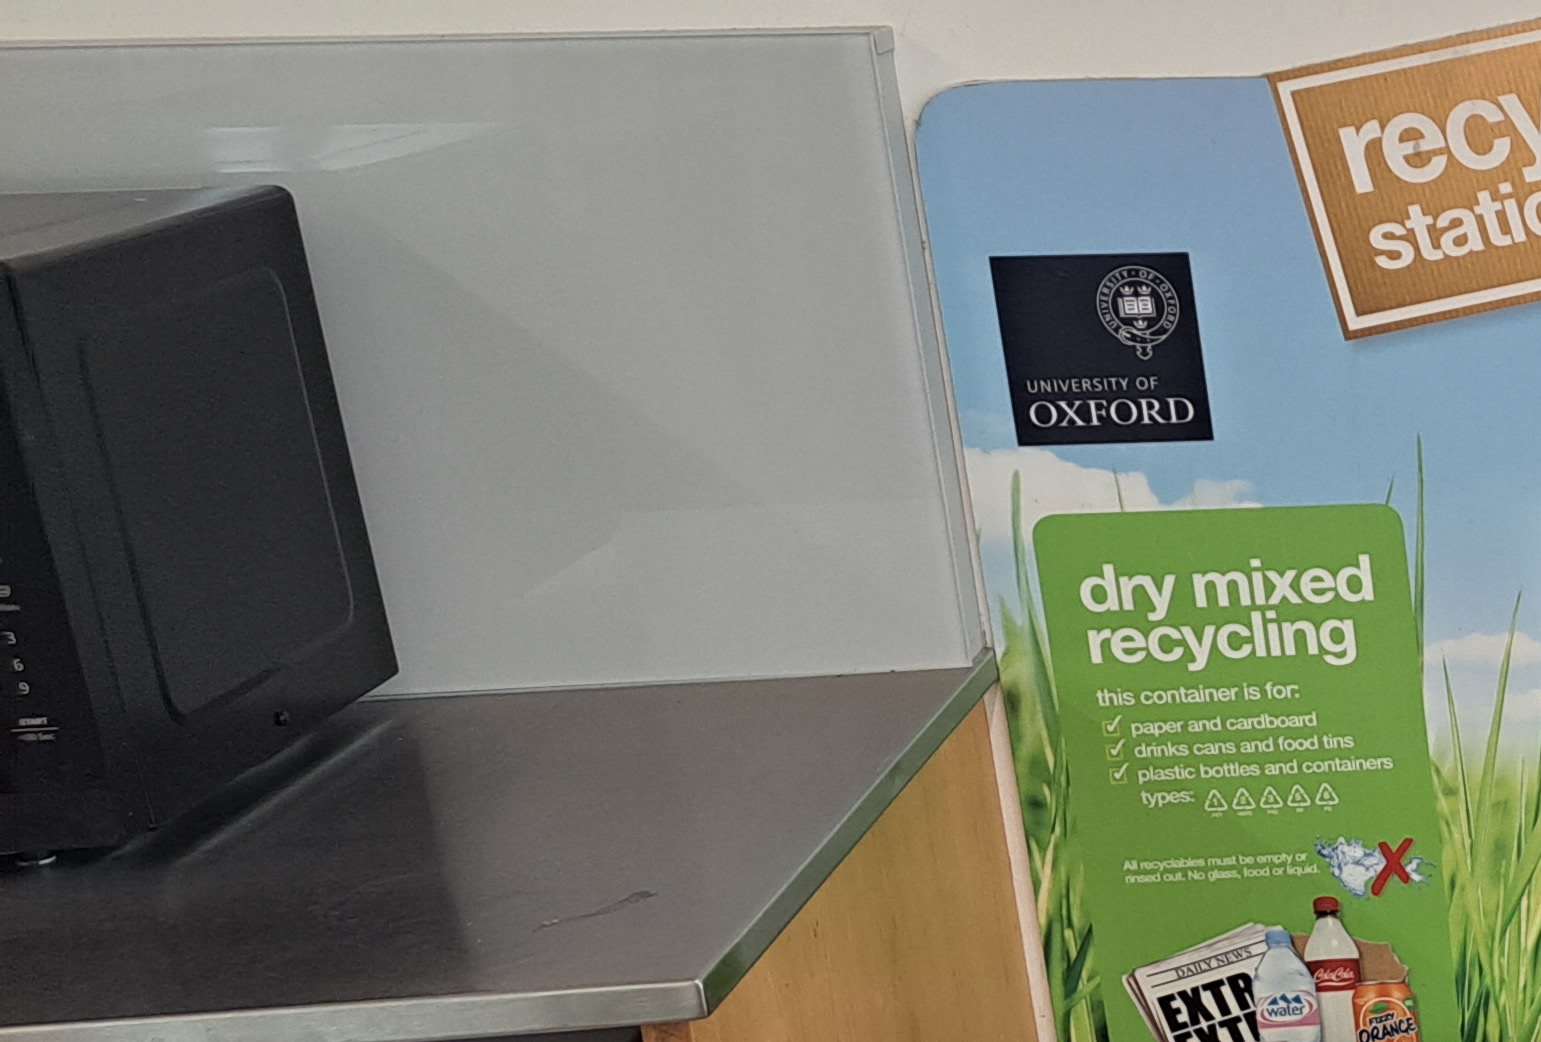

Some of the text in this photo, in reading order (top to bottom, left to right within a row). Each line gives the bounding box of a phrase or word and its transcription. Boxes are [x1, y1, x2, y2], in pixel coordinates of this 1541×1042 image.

[1027, 376, 1158, 393] UNIVERSITY OF
[1030, 397, 1195, 427] OXFORD
[1079, 554, 1374, 621] dry mixed
[1087, 610, 1357, 671] recycling
[1096, 681, 1299, 707] this container is for:
[1131, 711, 1317, 738] paper and cardboard
[1134, 733, 1354, 758] drinks cans and food tins
[1138, 754, 1393, 784] plastic bottles and containers
[1140, 789, 1194, 808] types:
[1175, 947, 1252, 978] DAILY NEWS
[1157, 972, 1256, 1032] EXTR
[1266, 1004, 1305, 1017] water
